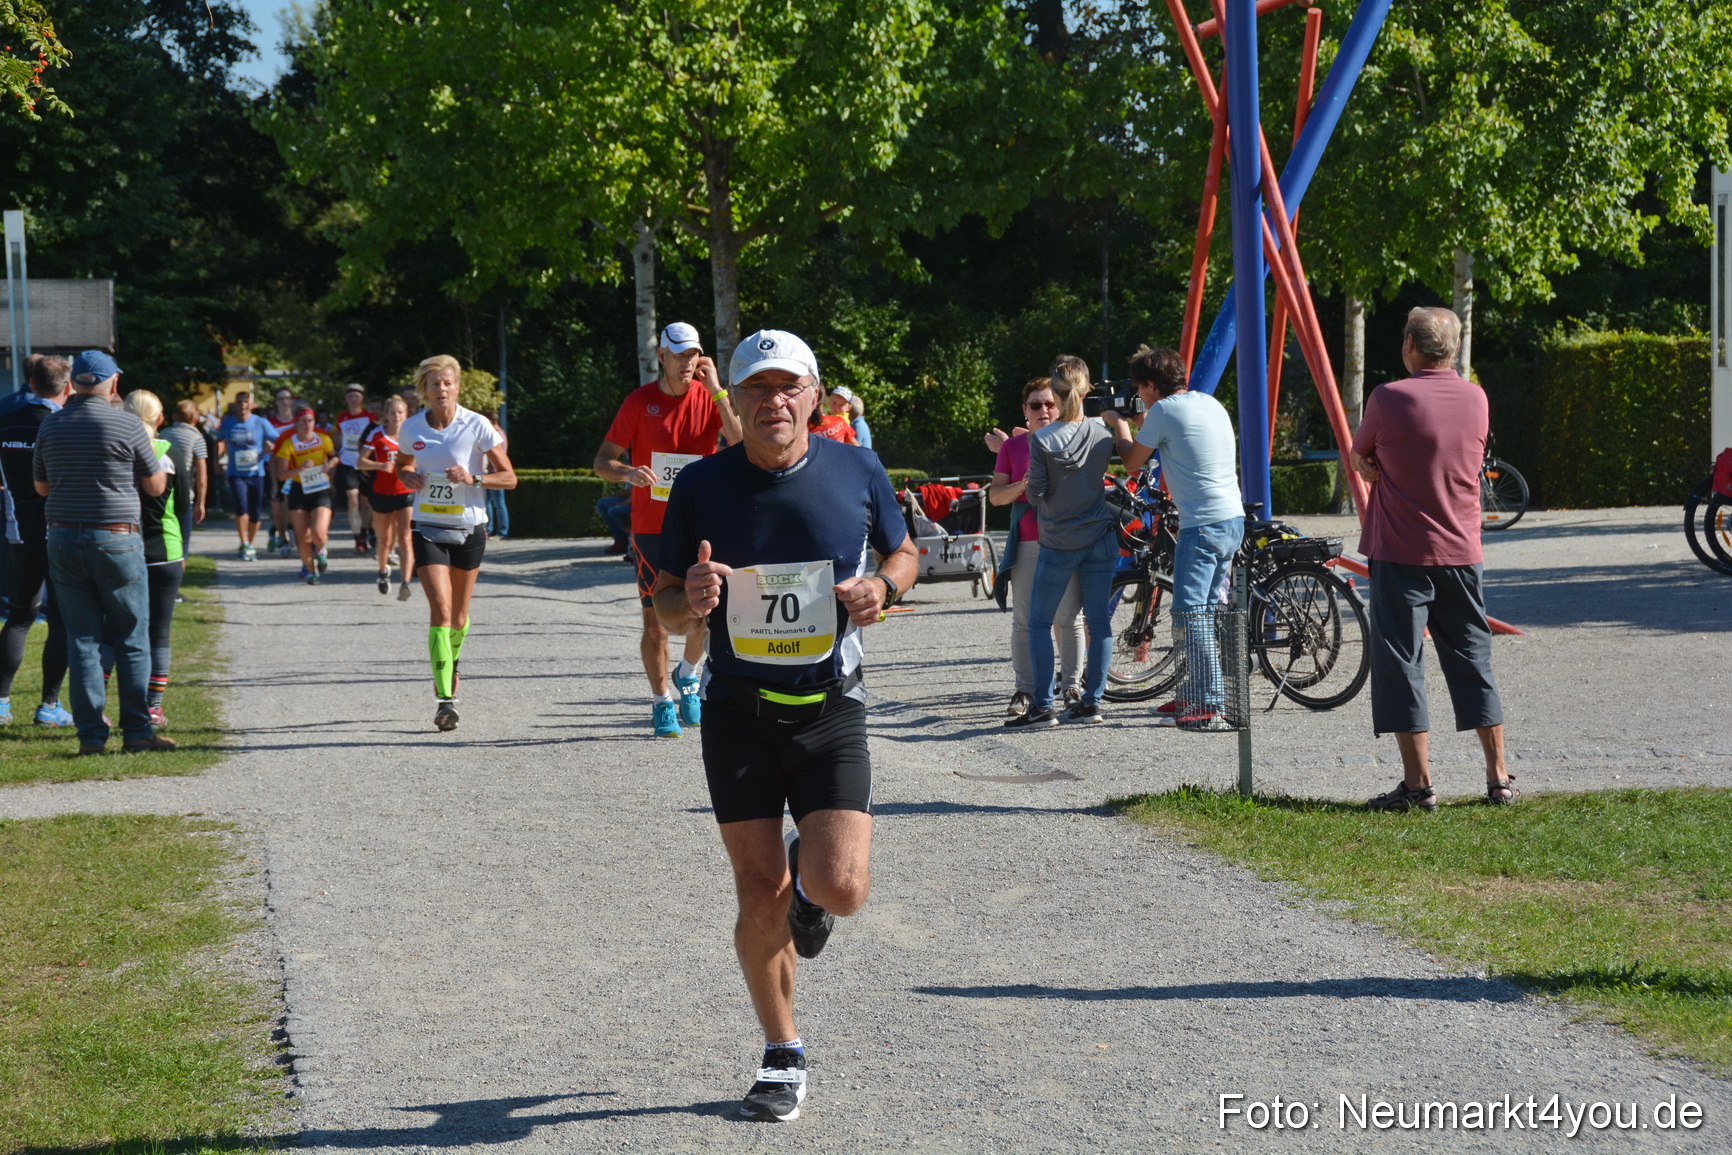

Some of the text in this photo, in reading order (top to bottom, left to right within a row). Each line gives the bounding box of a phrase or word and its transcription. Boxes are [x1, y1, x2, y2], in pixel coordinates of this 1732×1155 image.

[429, 484, 453, 499] 273
[756, 572, 803, 586] BOCK
[761, 592, 800, 624] 70
[774, 627, 806, 635] Neumarkt
[768, 640, 801, 654] Adolf
